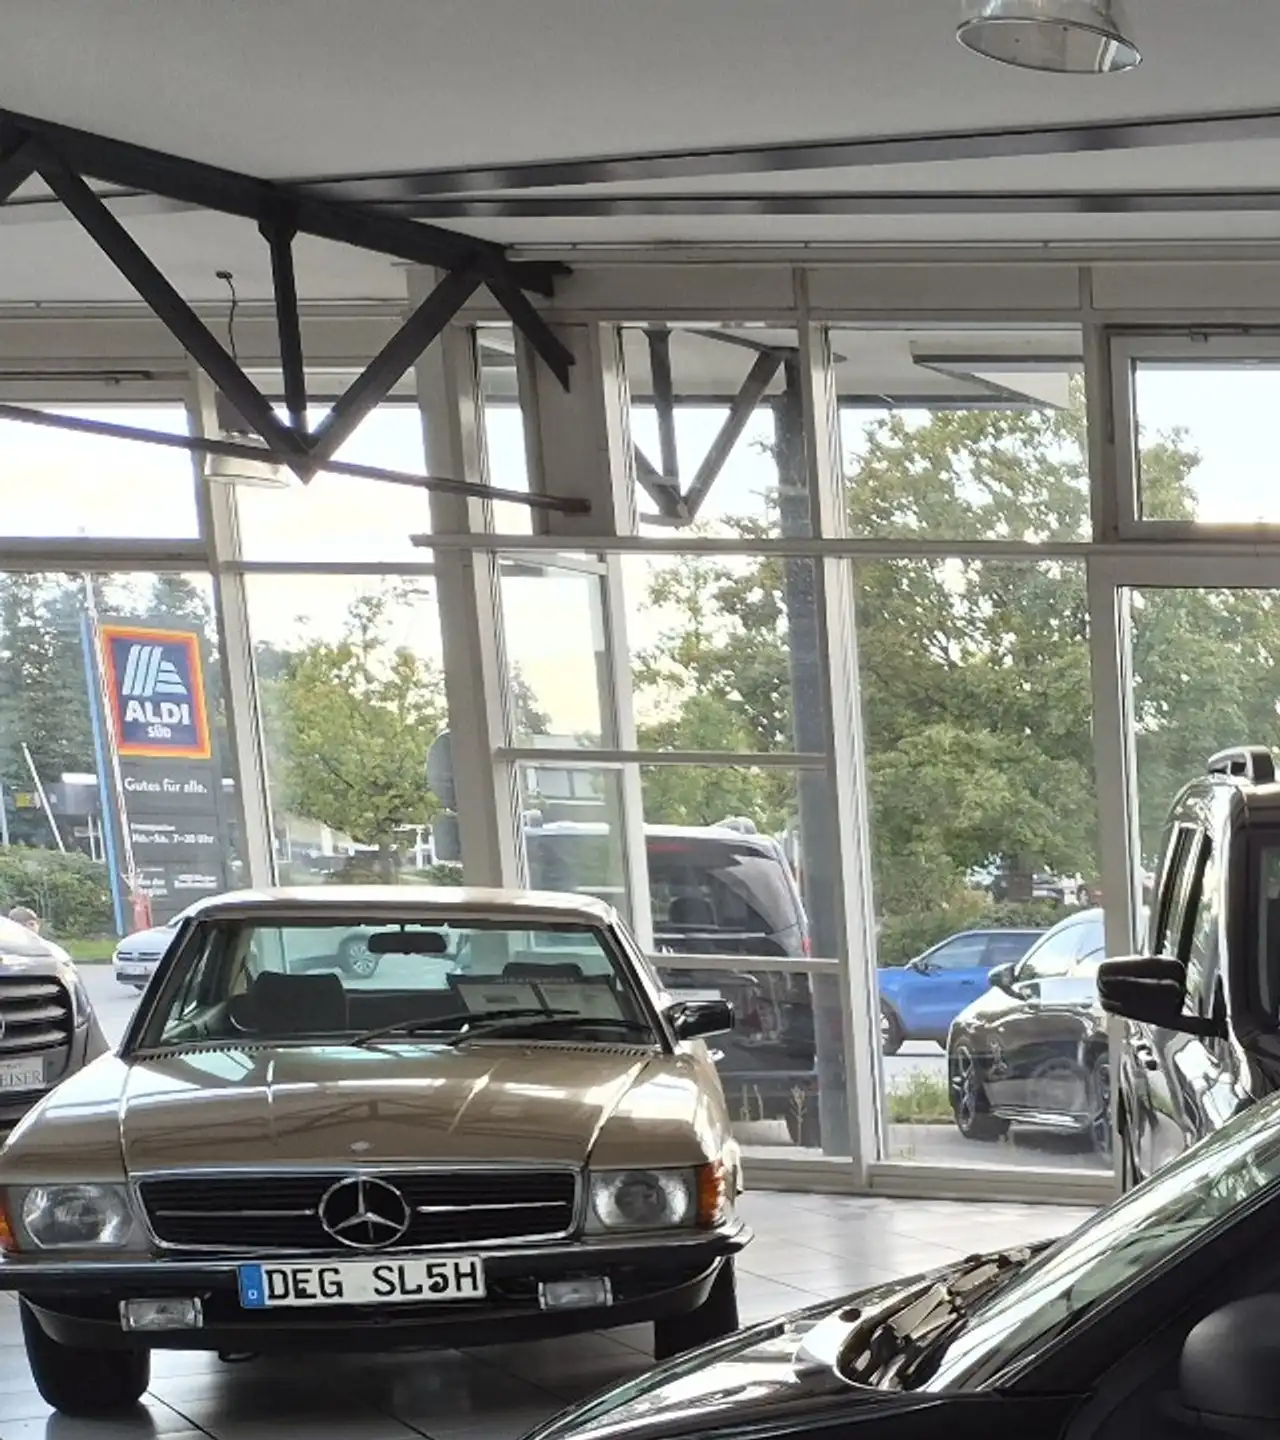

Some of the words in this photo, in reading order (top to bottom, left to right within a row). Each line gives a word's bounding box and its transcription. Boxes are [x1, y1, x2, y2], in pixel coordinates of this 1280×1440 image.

[124, 699, 190, 726] ALDI
[146, 723, 172, 739] SÜD
[124, 776, 161, 792] Gutes
[265, 1267, 343, 1300] DEG
[373, 1261, 478, 1297] SL5H
